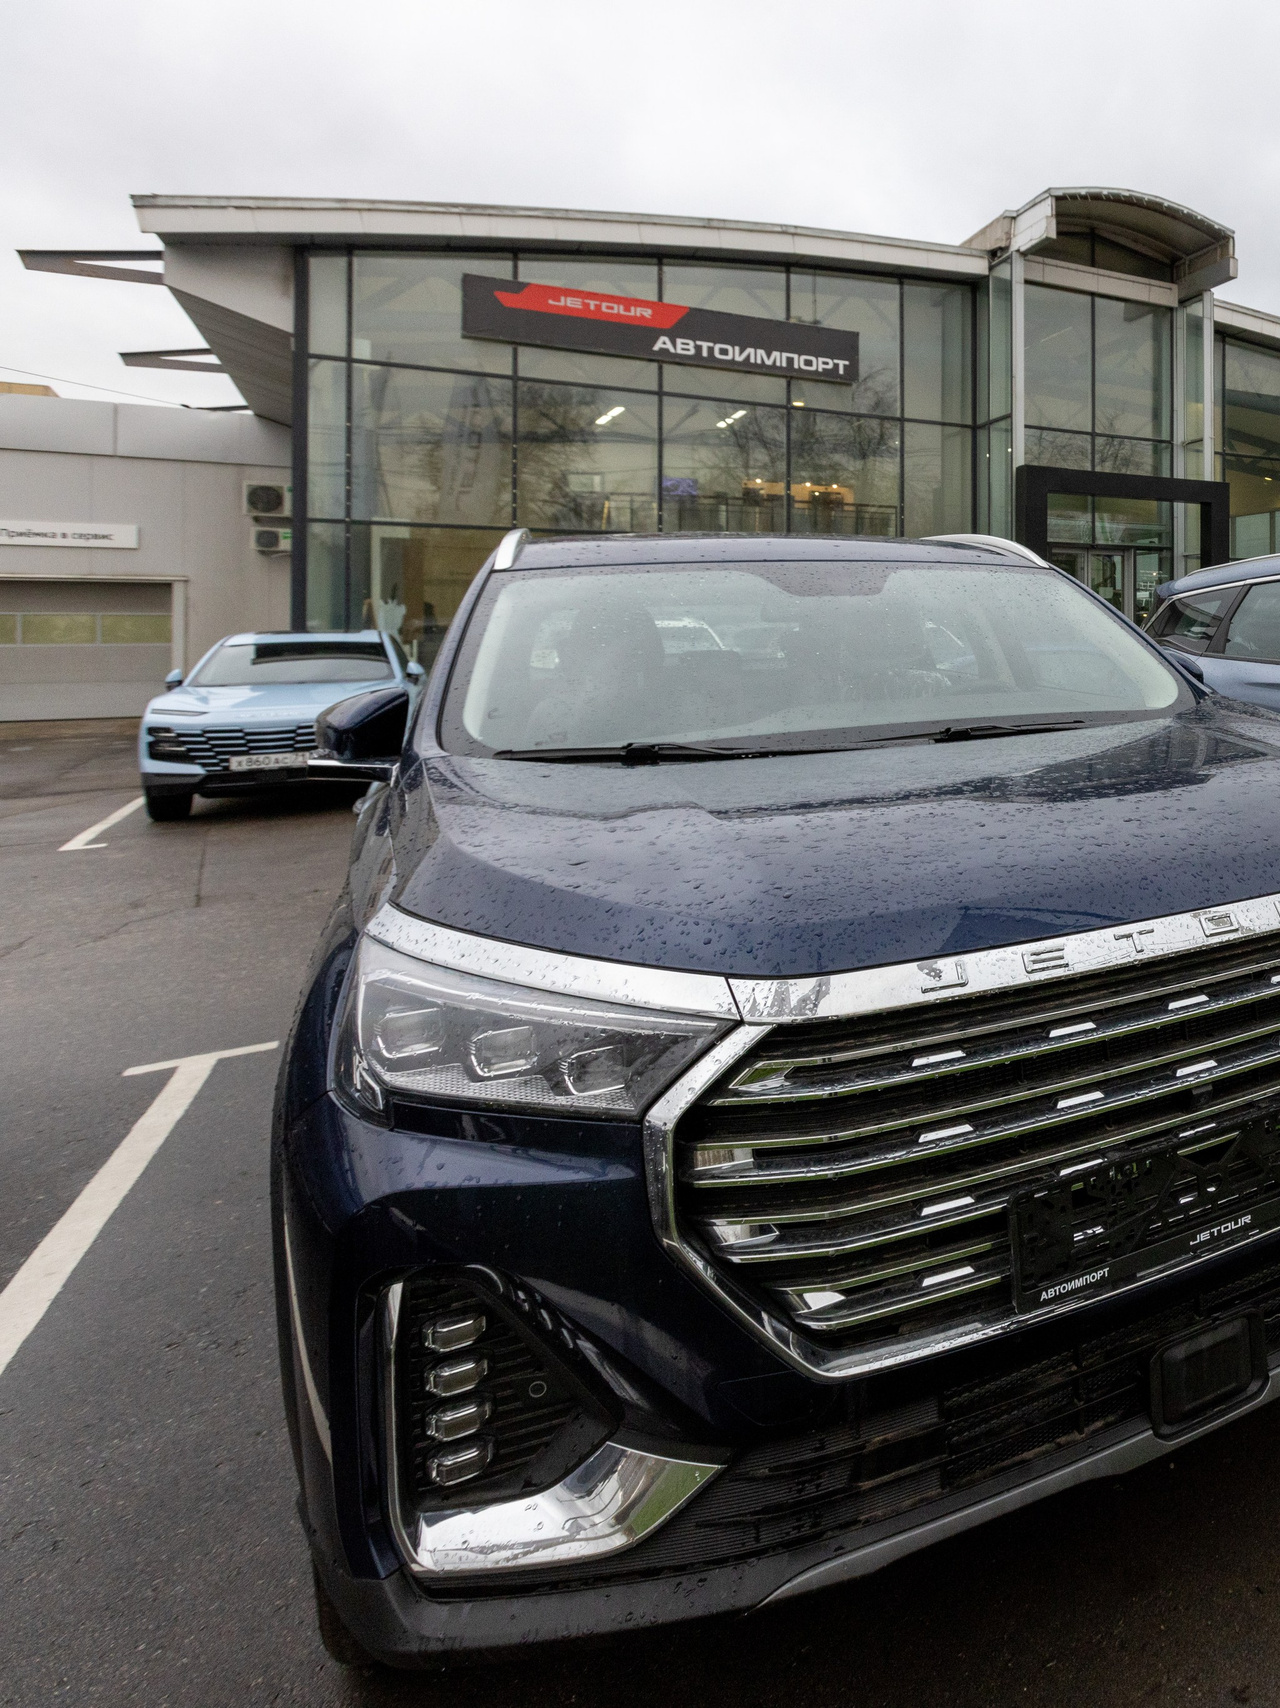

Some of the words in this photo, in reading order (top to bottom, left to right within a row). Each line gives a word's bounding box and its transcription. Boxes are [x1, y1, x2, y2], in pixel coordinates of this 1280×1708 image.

[548, 295, 653, 319] JETOUR
[652, 335, 850, 375] АВТОИМПОРТ
[1189, 1214, 1252, 1246] JETOUR
[1039, 1267, 1110, 1302] АВТОИМПОРТ
